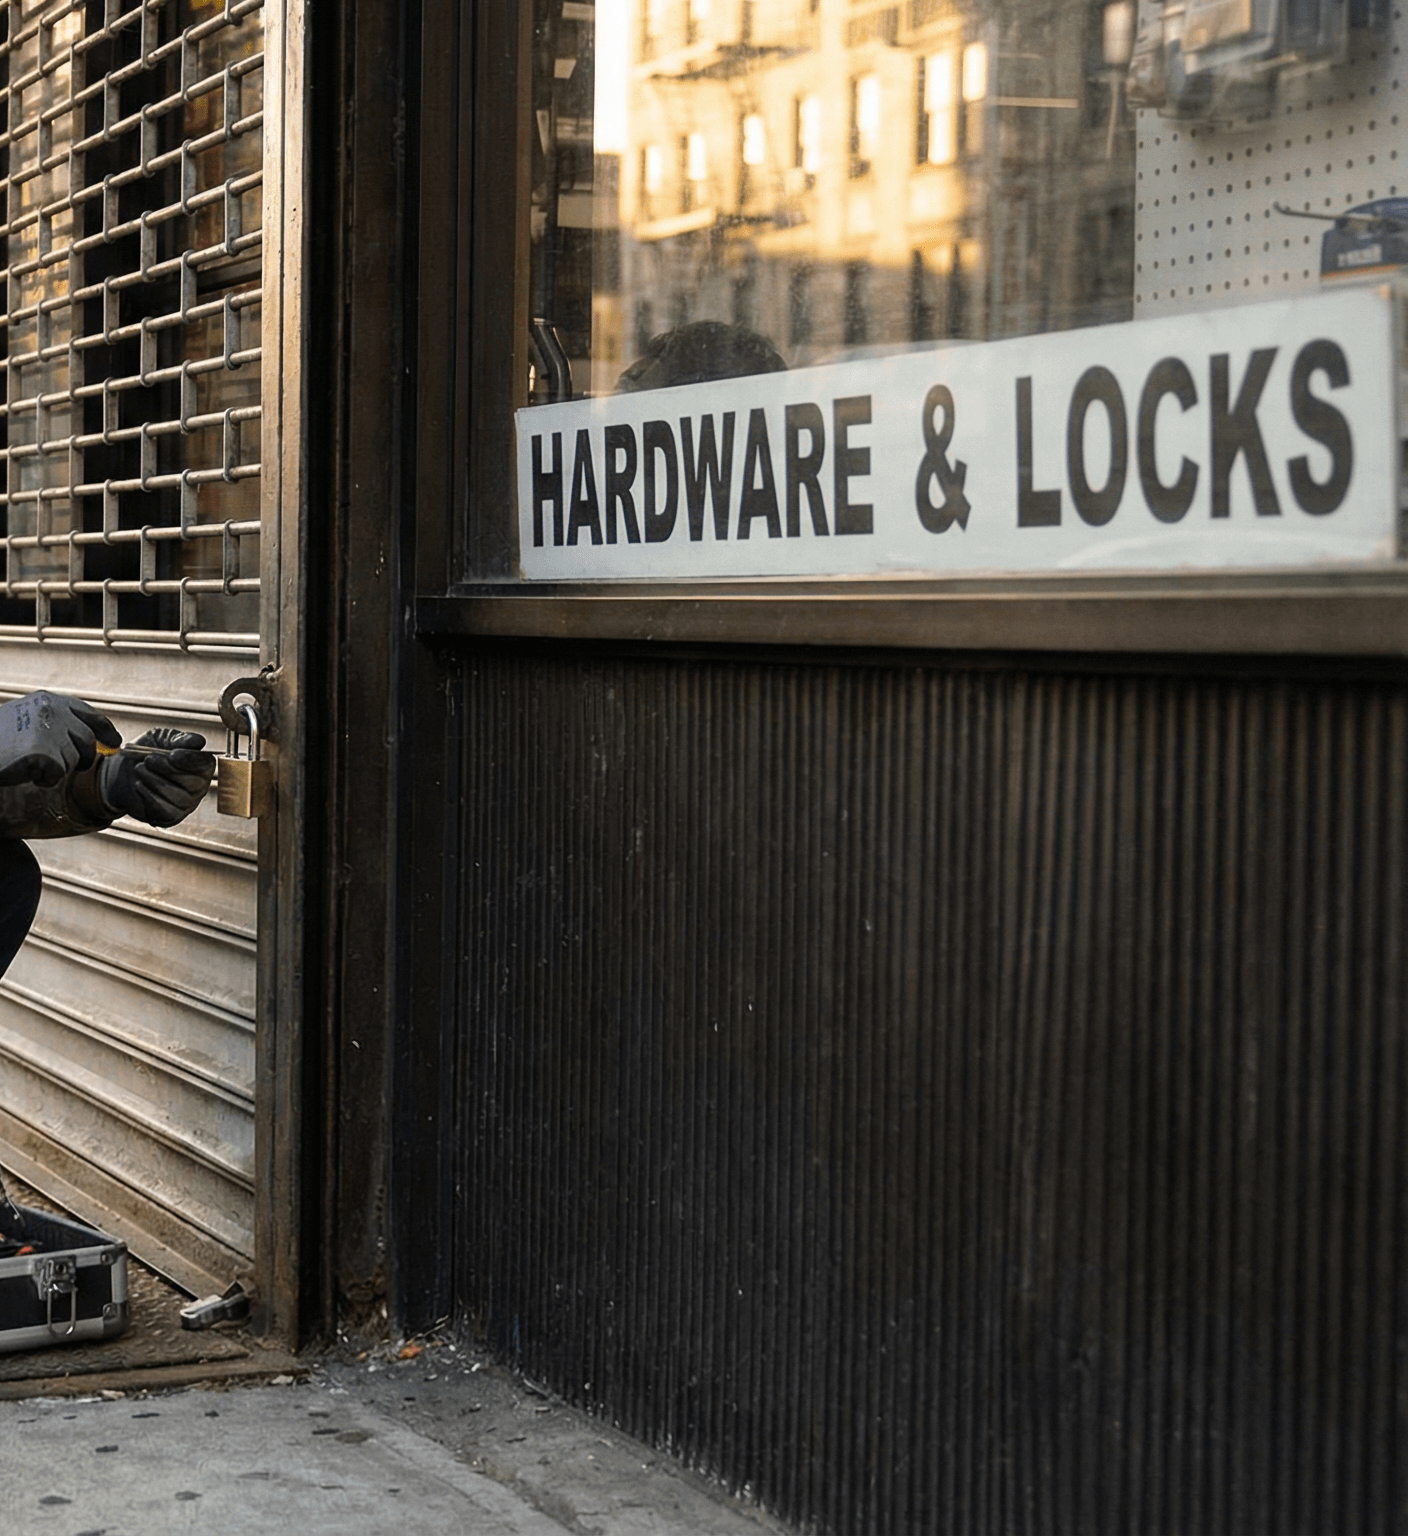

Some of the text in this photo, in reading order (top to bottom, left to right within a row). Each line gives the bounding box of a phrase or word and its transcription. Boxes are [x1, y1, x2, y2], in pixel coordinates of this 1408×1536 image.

[531, 339, 1354, 548] HARDWARE & LOCKS
